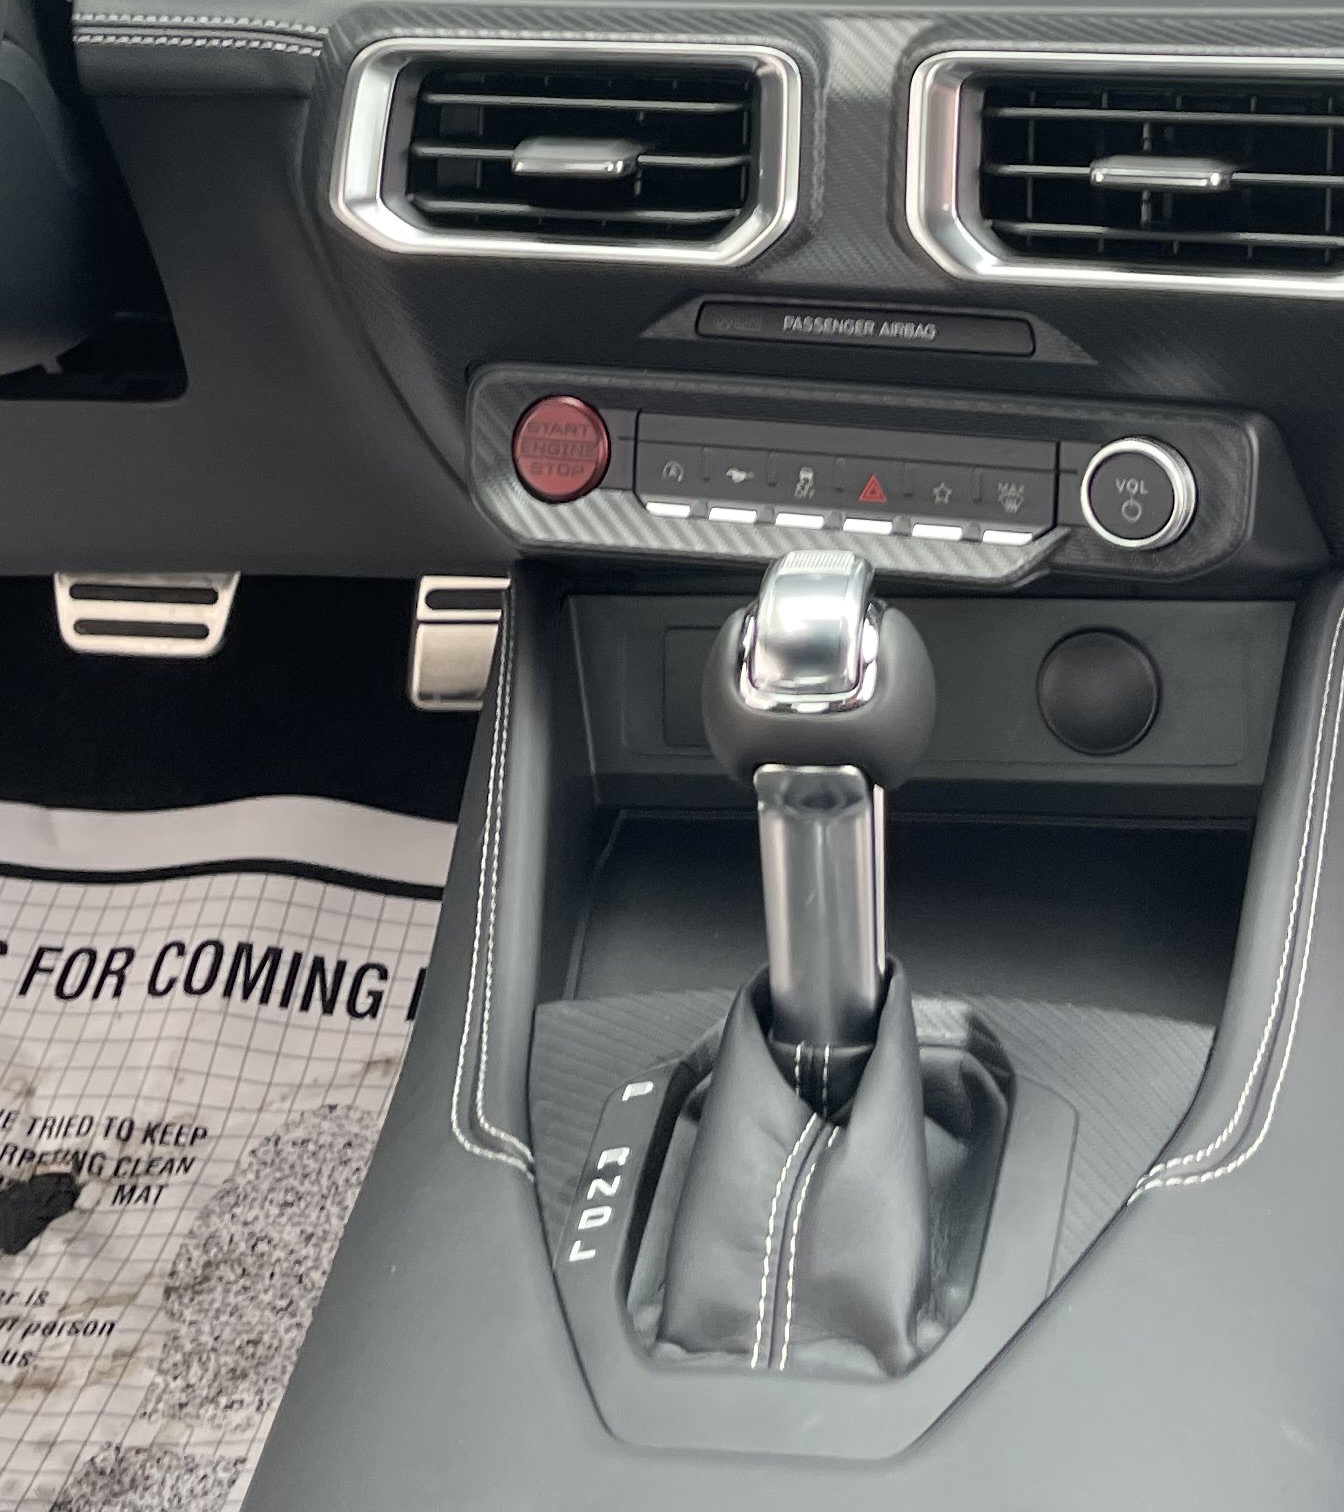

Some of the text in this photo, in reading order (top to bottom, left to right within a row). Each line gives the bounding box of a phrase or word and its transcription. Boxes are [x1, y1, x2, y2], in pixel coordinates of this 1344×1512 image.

[783, 314, 938, 341] PASSENGER AIRBAG
[527, 420, 588, 437] START
[520, 441, 597, 458] ENGINE
[530, 461, 585, 477] STOP
[1114, 477, 1150, 495] VOL
[17, 945, 136, 1001] FOR
[147, 939, 390, 1020] COMING
[621, 1081, 654, 1102] P
[26, 1114, 94, 1140] TRIED
[103, 1116, 136, 1145] TO
[141, 1121, 208, 1148] KEEP
[112, 1156, 196, 1179] CLEAN
[596, 1146, 631, 1170] R
[111, 1183, 170, 1207] MAT
[586, 1175, 622, 1201] N
[577, 1206, 613, 1230] D
[568, 1239, 597, 1263] L
[23, 1287, 50, 1308] is
[22, 1317, 118, 1340] person
